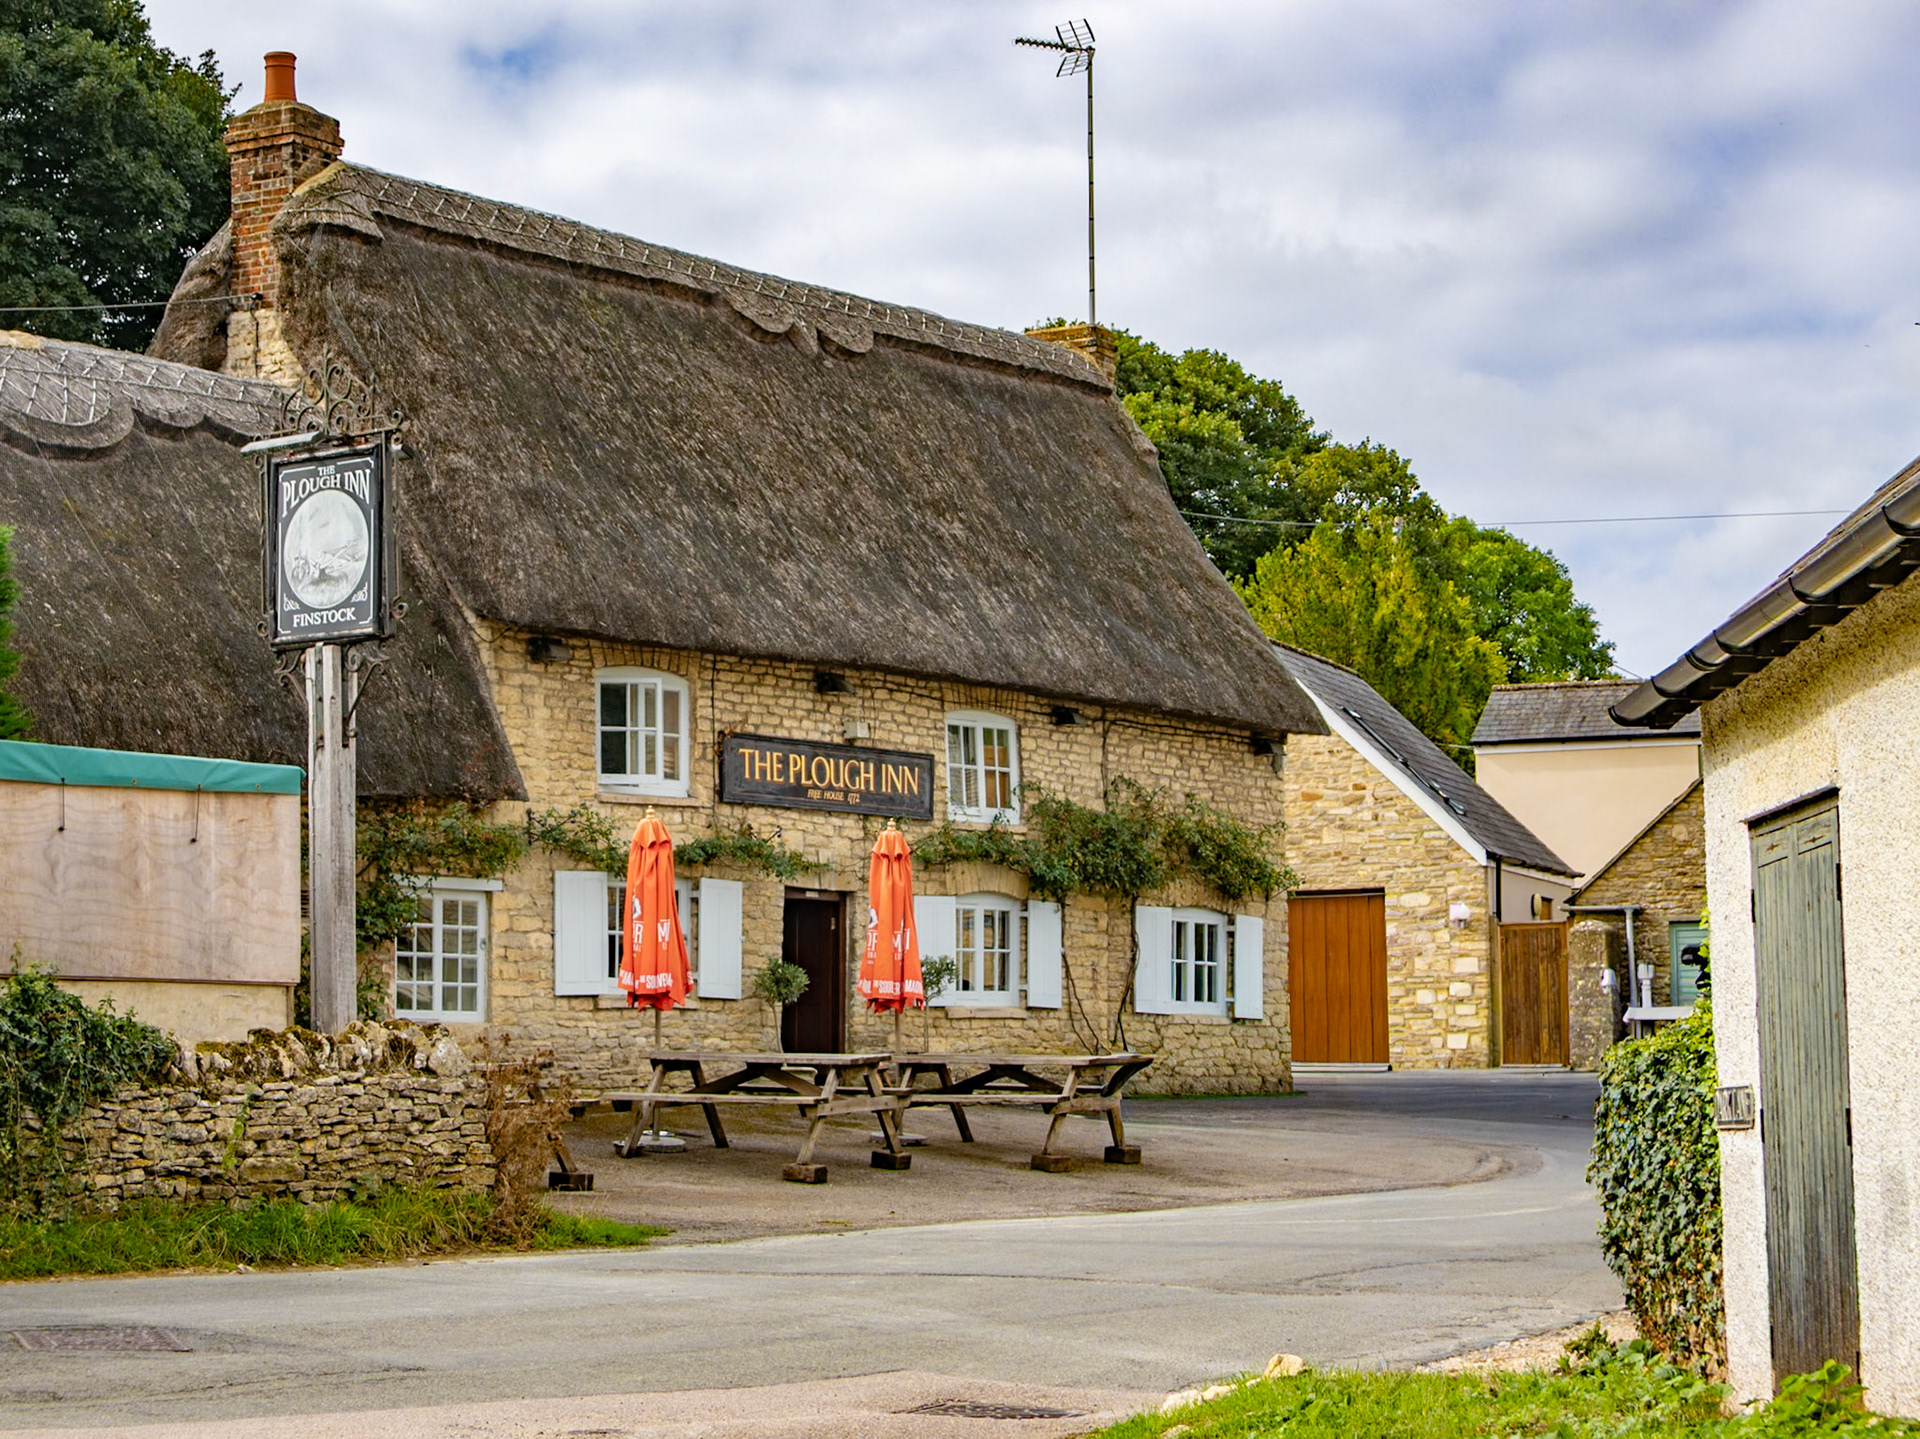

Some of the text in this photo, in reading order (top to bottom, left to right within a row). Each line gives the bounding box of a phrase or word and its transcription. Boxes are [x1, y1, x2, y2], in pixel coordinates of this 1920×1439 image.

[317, 465, 336, 476] THE
[281, 468, 371, 518] PLOUGH INN
[292, 607, 357, 628] FINSTOCK
[738, 748, 919, 796] THE PLOUGH INN
[807, 788, 822, 800] FREE
[823, 790, 845, 801] HOUSE
